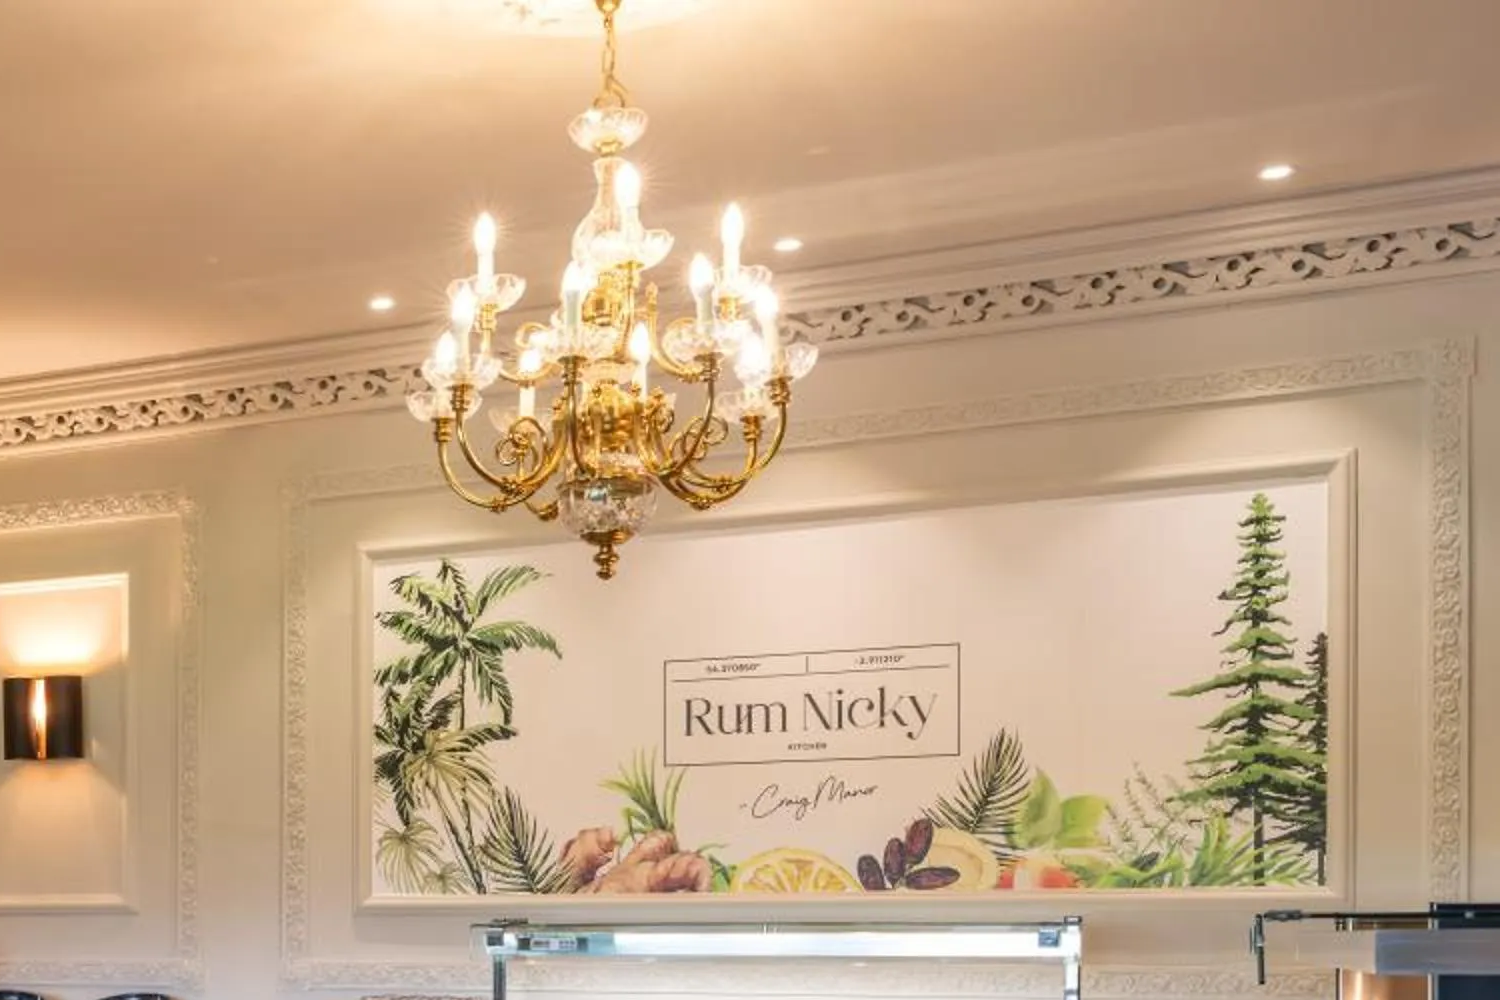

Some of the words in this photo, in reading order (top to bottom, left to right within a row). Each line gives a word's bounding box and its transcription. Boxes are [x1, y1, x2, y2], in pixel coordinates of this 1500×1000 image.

[683, 697, 788, 737] Rum
[802, 685, 939, 740] Nicky
[751, 783, 811, 821] Craig
[812, 775, 879, 809] Manor
